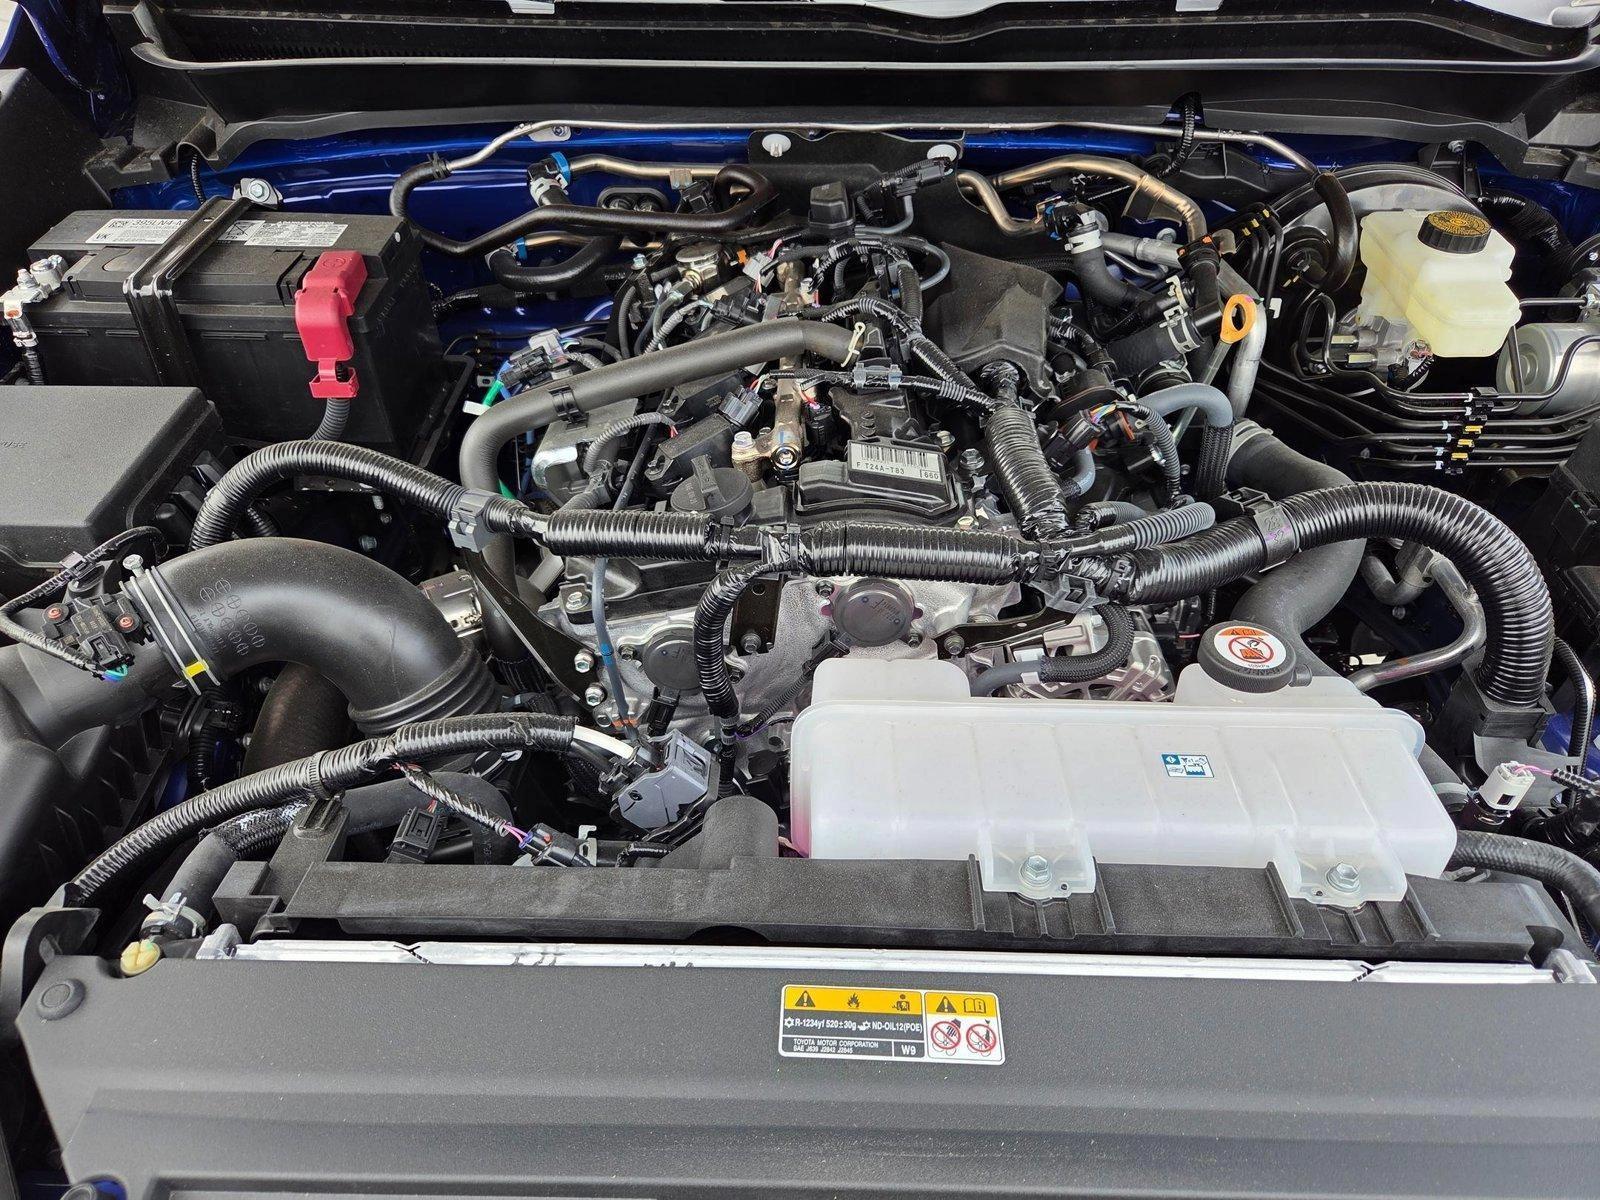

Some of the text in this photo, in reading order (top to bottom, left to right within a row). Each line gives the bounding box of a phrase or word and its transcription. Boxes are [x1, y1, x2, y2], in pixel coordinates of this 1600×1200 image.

[795, 1018, 825, 1029] R-1234yf
[793, 1038, 879, 1049] TOYOTA MOTOR CORPORATION
[901, 1044, 917, 1056] W9
